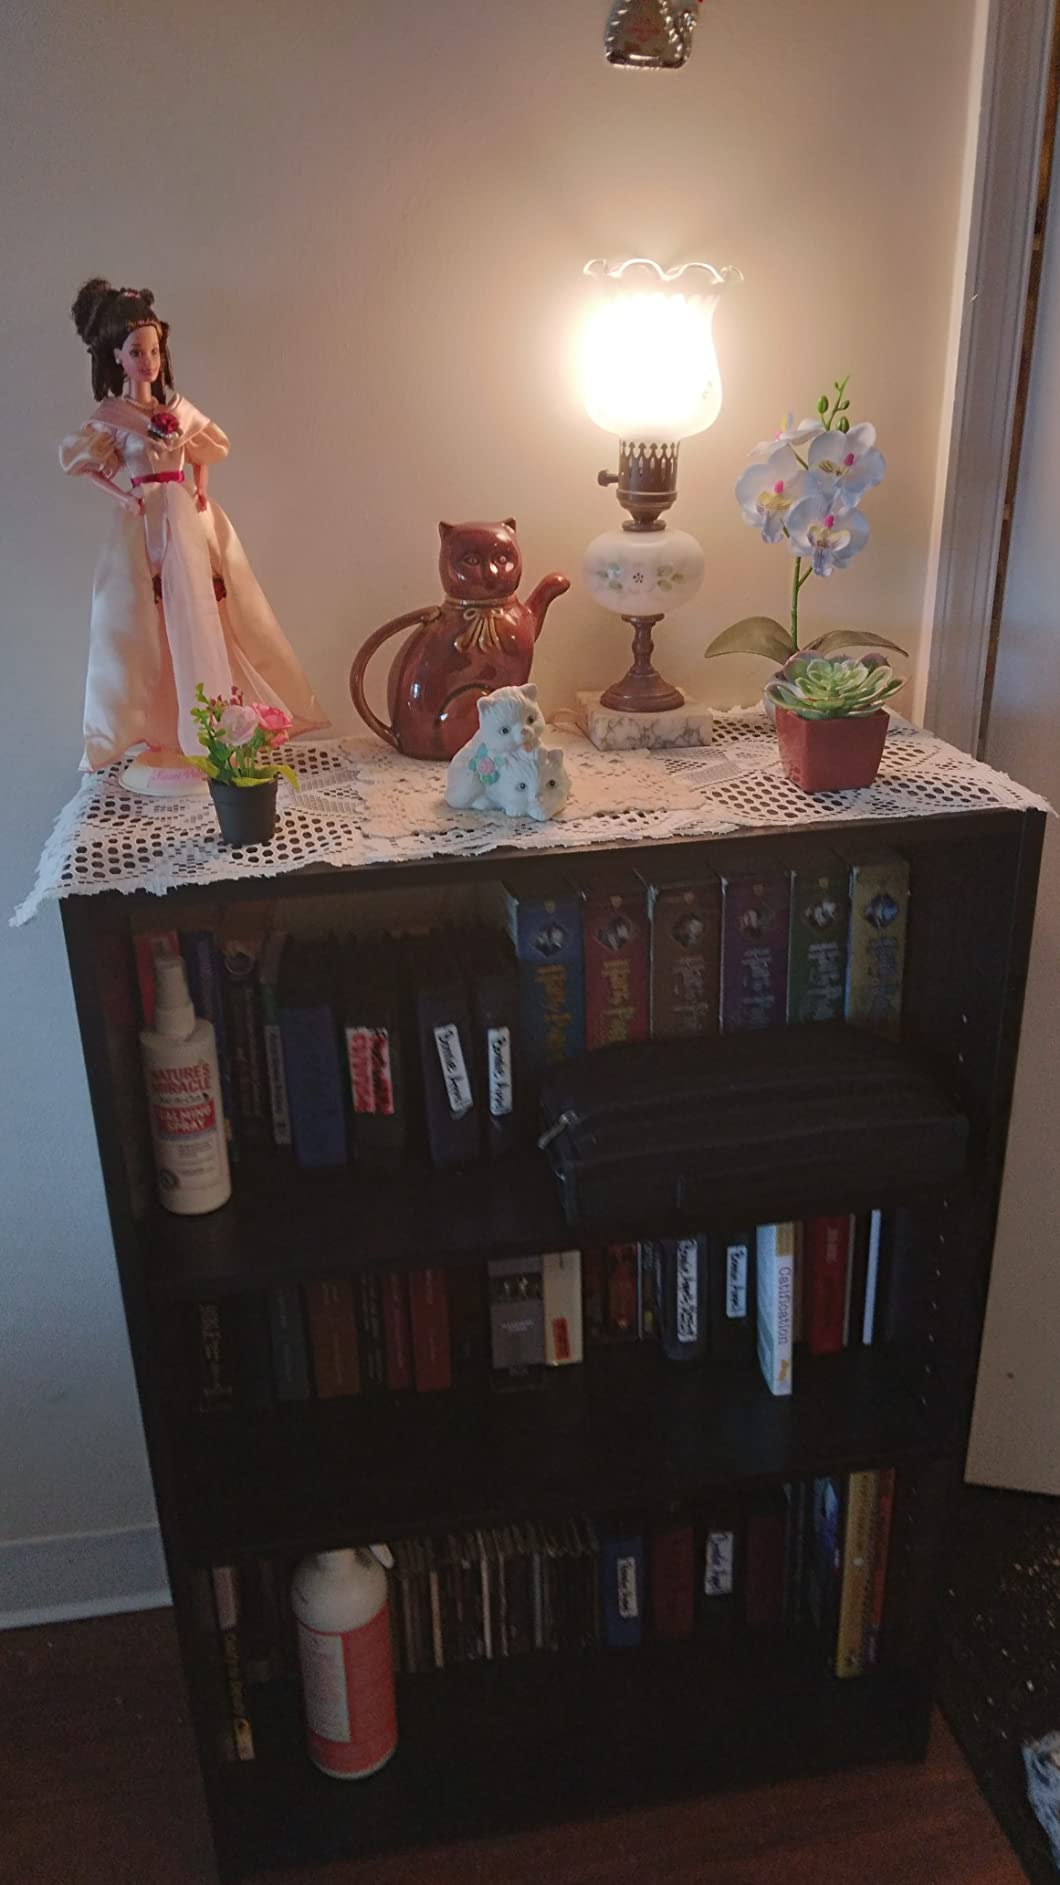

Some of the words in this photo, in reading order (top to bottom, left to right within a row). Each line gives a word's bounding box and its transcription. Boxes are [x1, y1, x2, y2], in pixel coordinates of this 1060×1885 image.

[152, 1077, 211, 1094] MIRACLE
[167, 1118, 204, 1132] SPRAY
[777, 1266, 792, 1345] Catification
